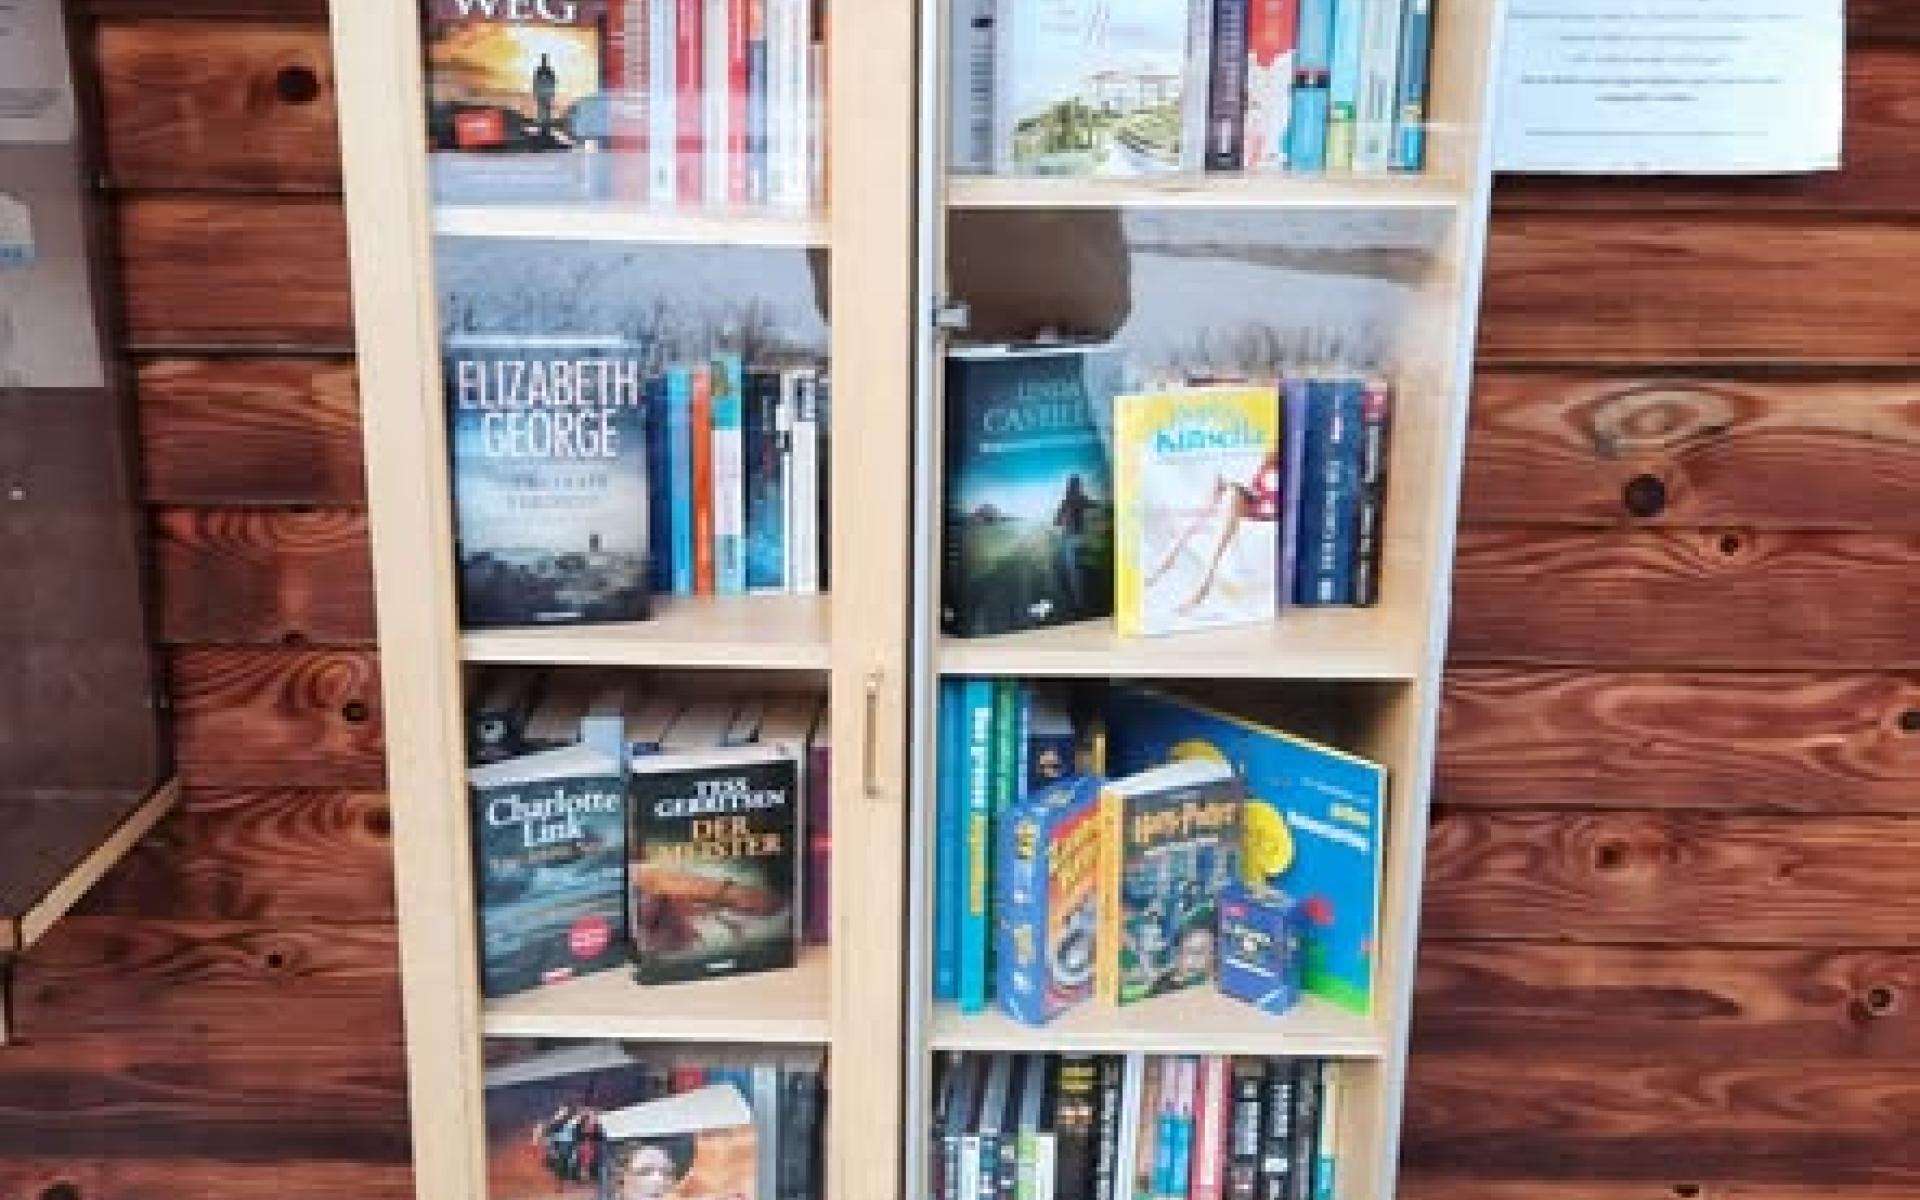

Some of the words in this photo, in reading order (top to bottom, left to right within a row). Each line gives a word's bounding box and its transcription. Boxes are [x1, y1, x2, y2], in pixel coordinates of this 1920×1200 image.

[458, 359, 639, 410] ELIZABETH
[483, 407, 618, 459] GEORGE
[487, 787, 621, 827] Charlotte
[522, 808, 586, 848] Link
